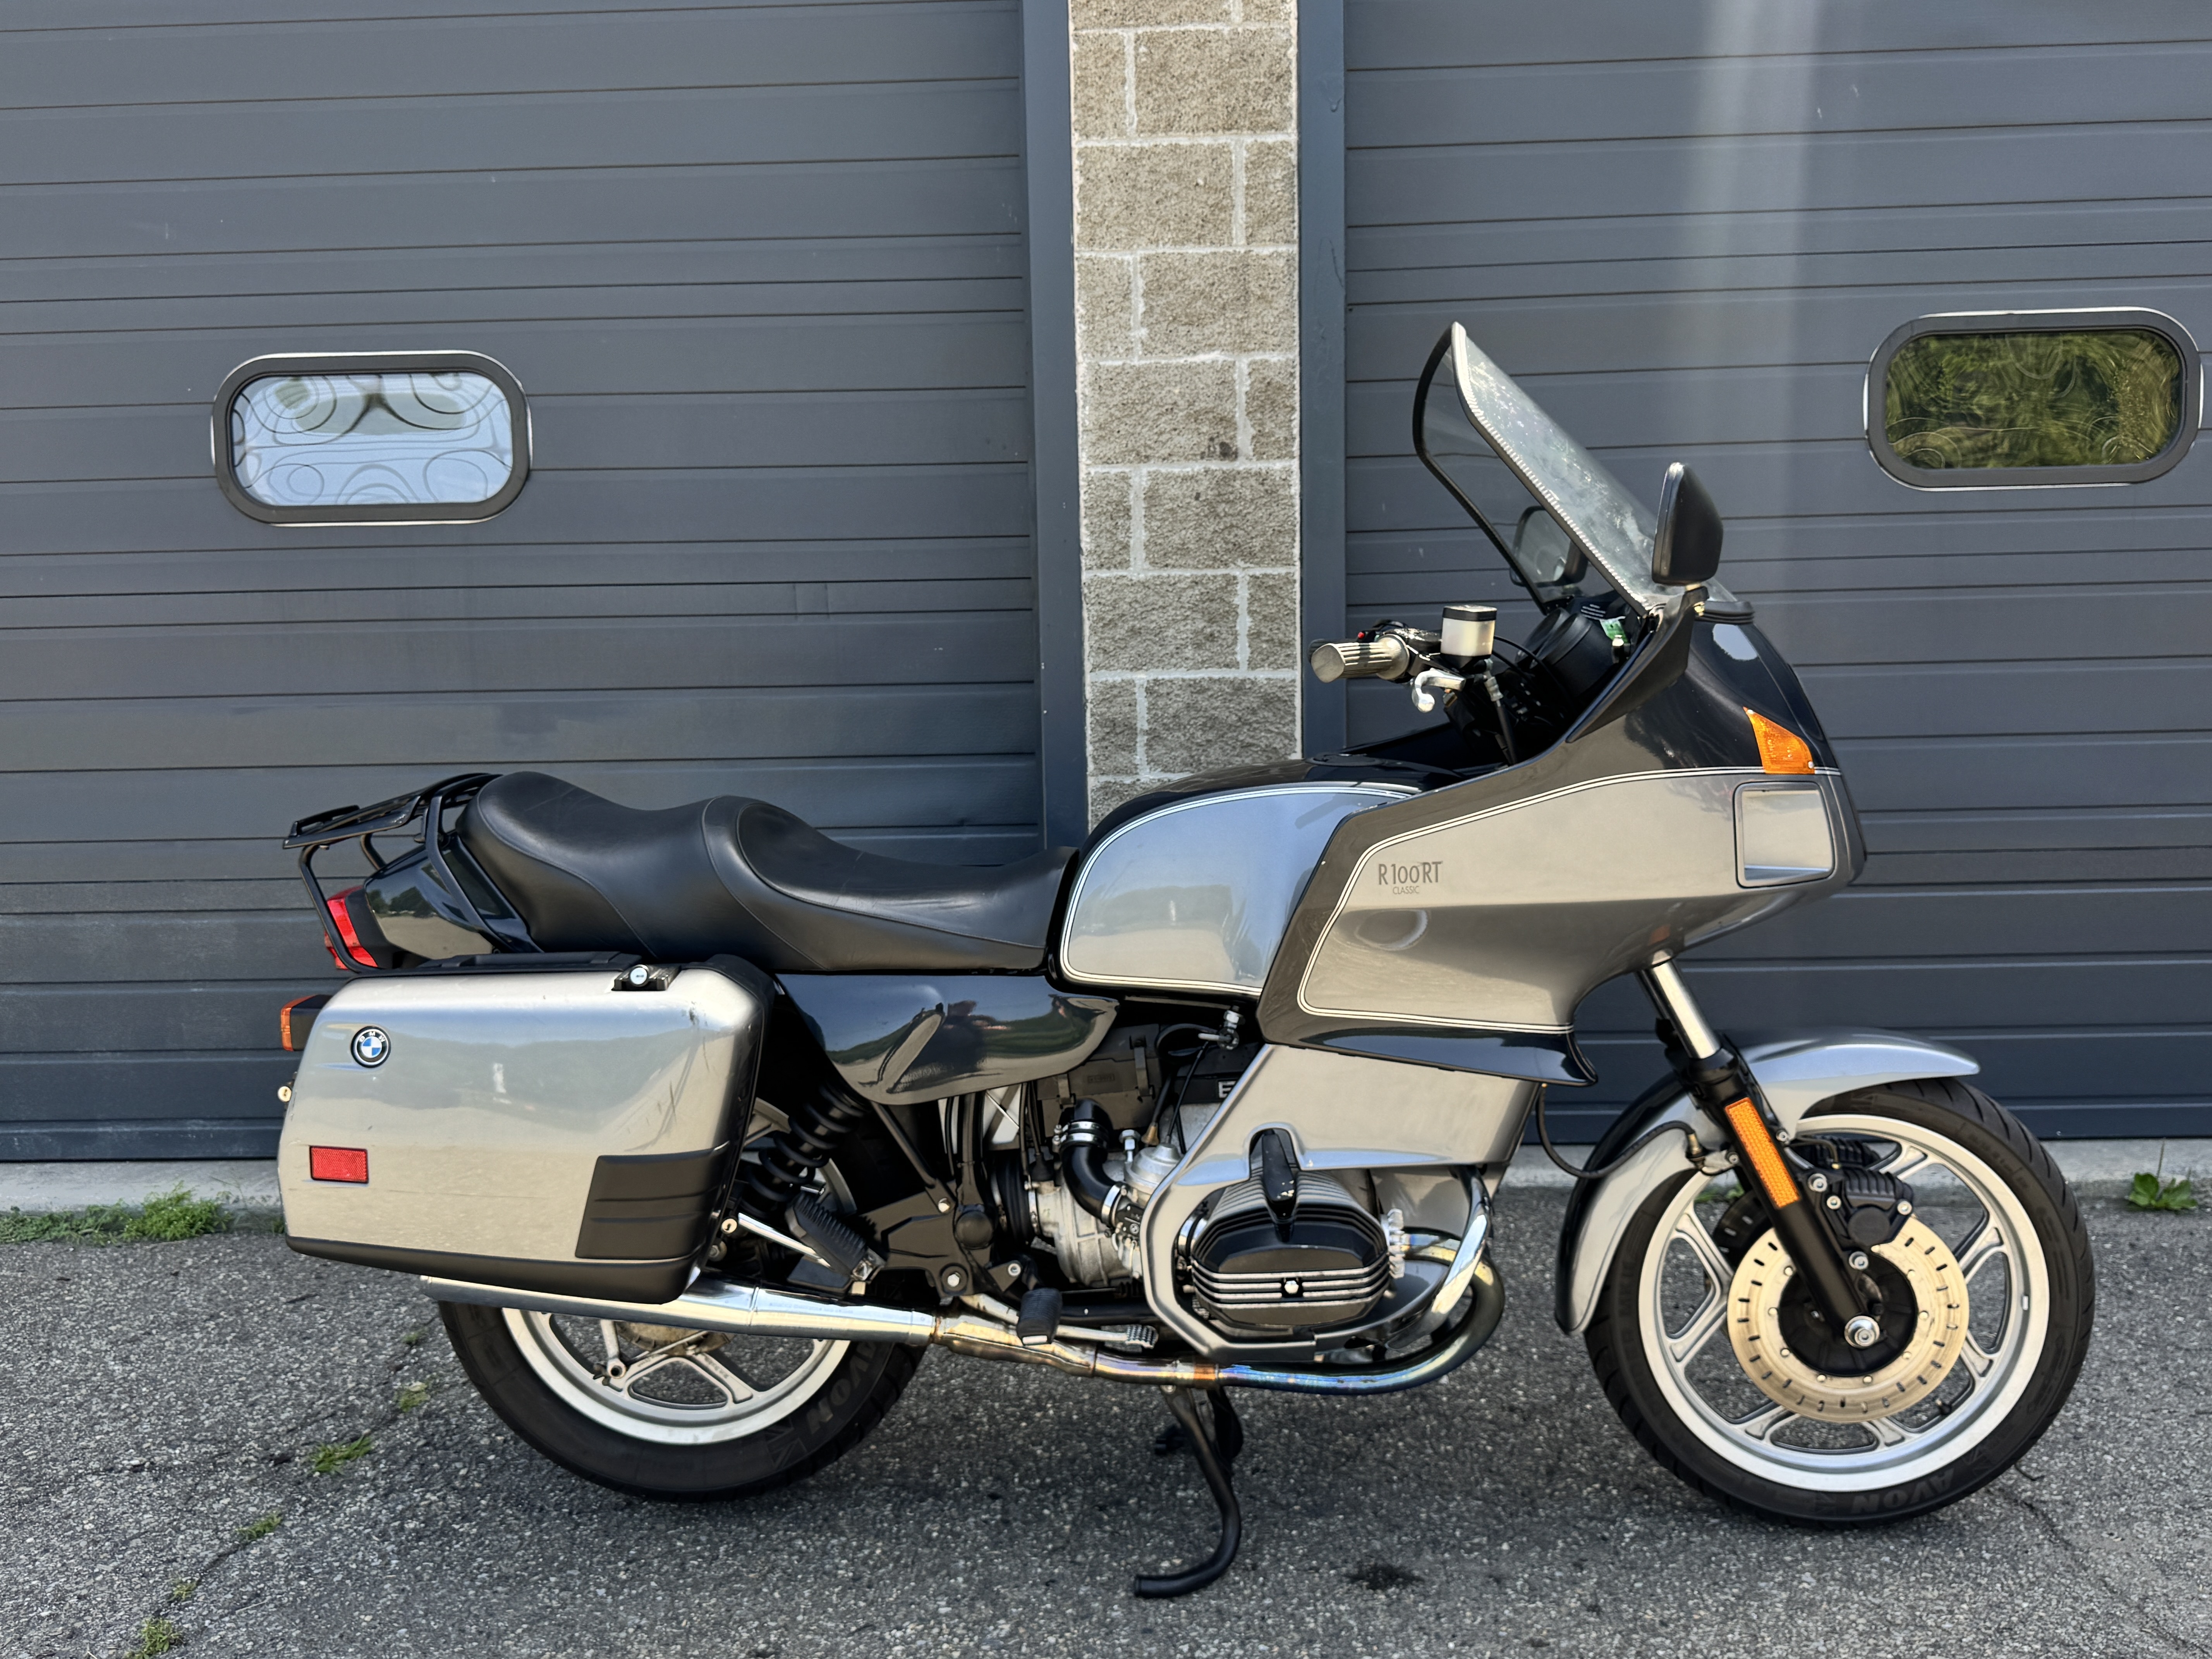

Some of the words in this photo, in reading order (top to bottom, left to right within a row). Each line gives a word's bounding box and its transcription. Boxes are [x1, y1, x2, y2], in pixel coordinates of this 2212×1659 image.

[1393, 886, 1420, 895] CLASSIC
[359, 1031, 386, 1042] BMW
[806, 1340, 877, 1434] AVON
[1851, 1467, 1955, 1513] AVON
